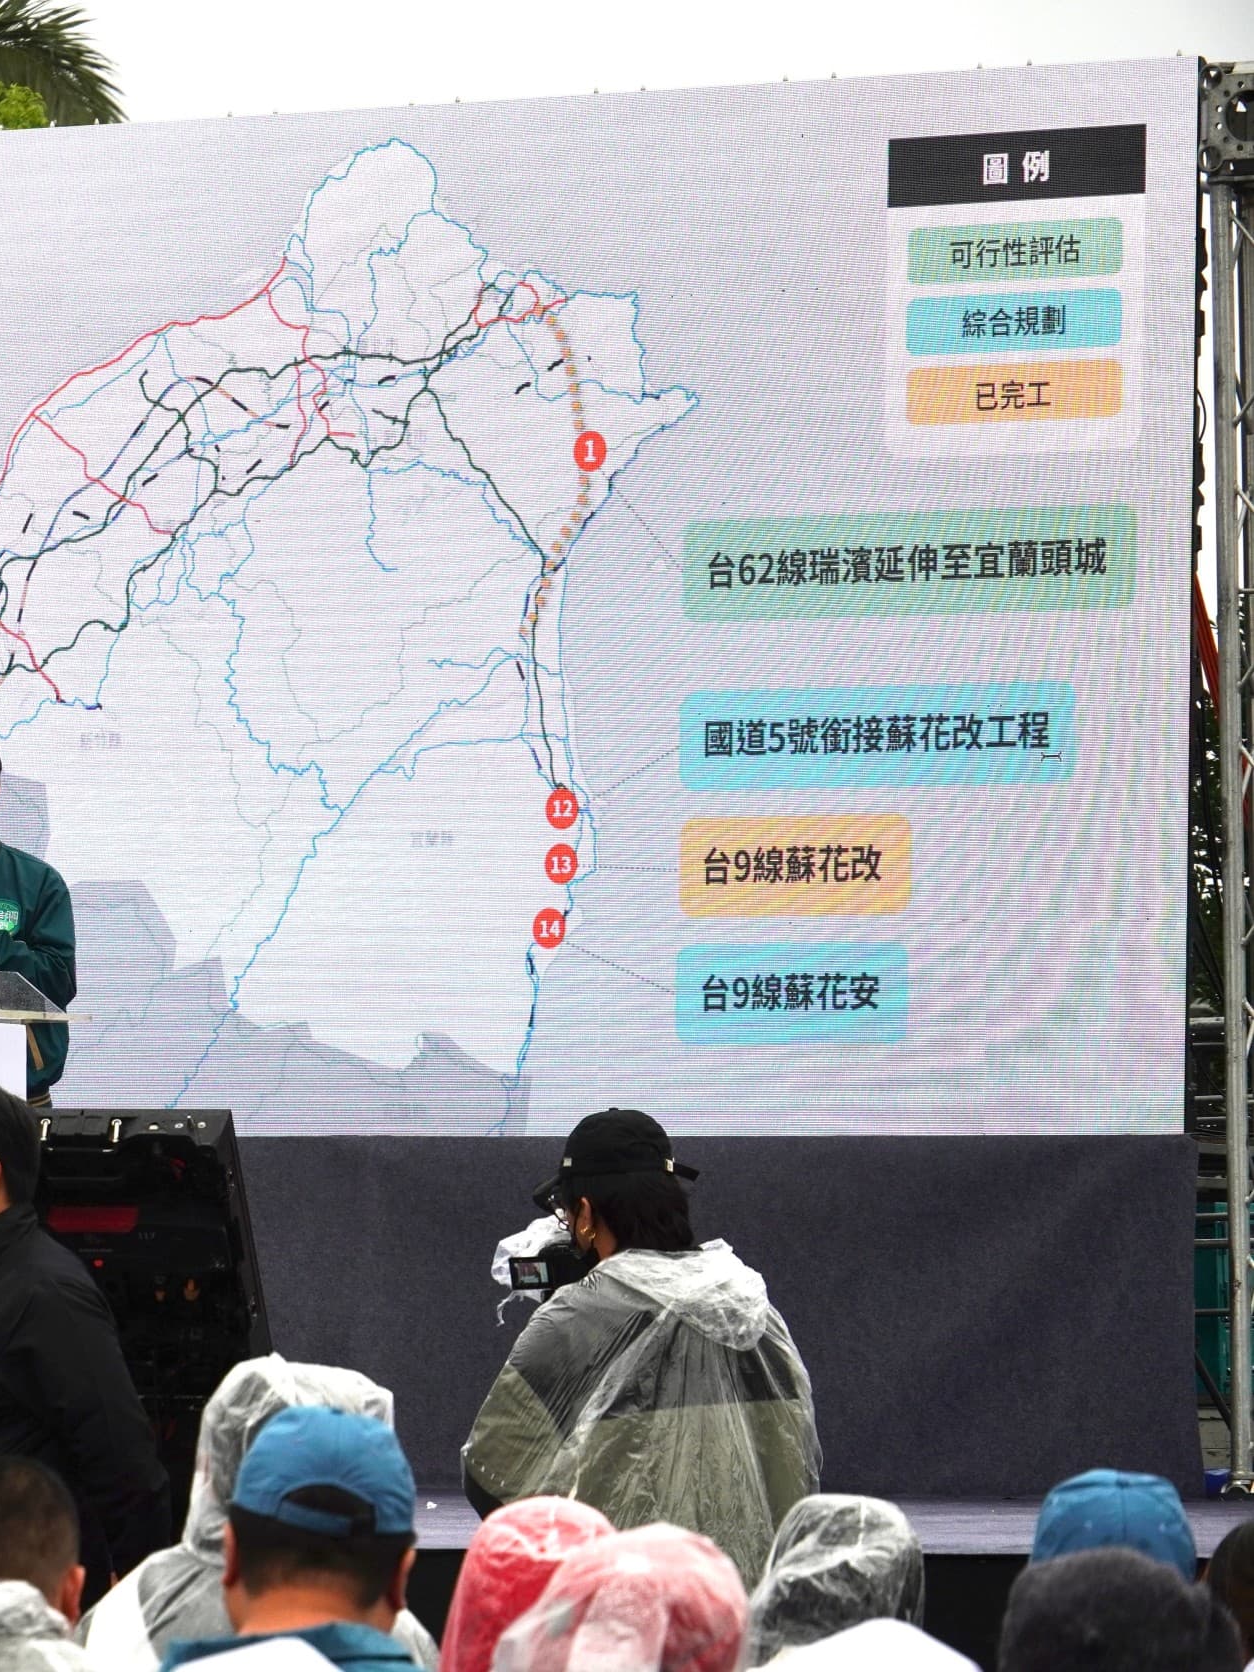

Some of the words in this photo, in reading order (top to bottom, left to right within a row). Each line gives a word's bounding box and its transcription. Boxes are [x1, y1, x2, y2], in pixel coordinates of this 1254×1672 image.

[981, 149, 1051, 186] 圖例
[950, 235, 1081, 270] 可行性評估
[961, 305, 1067, 339] 綜合規劃
[975, 381, 1051, 411] 已完工
[584, 440, 596, 463] 1
[707, 538, 1107, 590] 台62線瑞濱延伸至宜蘭頭城
[704, 711, 1050, 758] 國道5號銜接蘇花改工程
[552, 800, 573, 817] 12
[551, 856, 571, 874] 13
[703, 845, 882, 885] 台9線蘇花改
[540, 920, 560, 938] 14
[701, 972, 880, 1012] 台9線蘇花安
